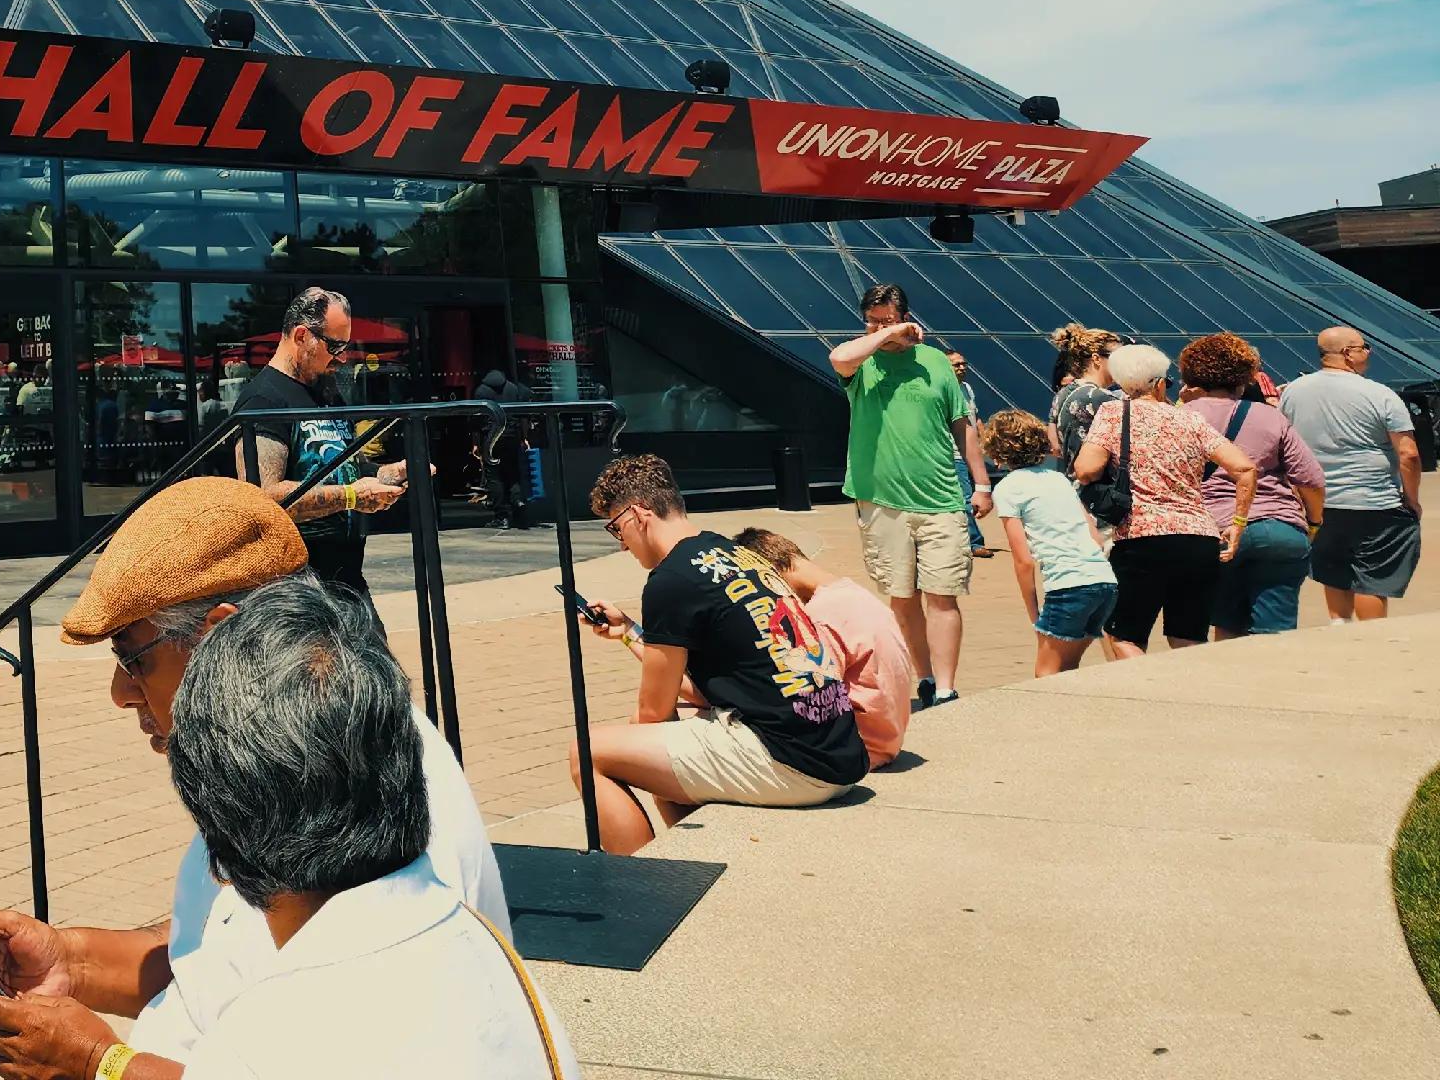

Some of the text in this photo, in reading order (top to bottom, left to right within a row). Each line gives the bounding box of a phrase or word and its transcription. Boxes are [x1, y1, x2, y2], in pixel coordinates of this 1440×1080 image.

[300, 71, 466, 158] OF
[461, 83, 736, 177] FAME
[865, 170, 967, 191] MORTGAGE
[985, 155, 1076, 186] PLAZA
